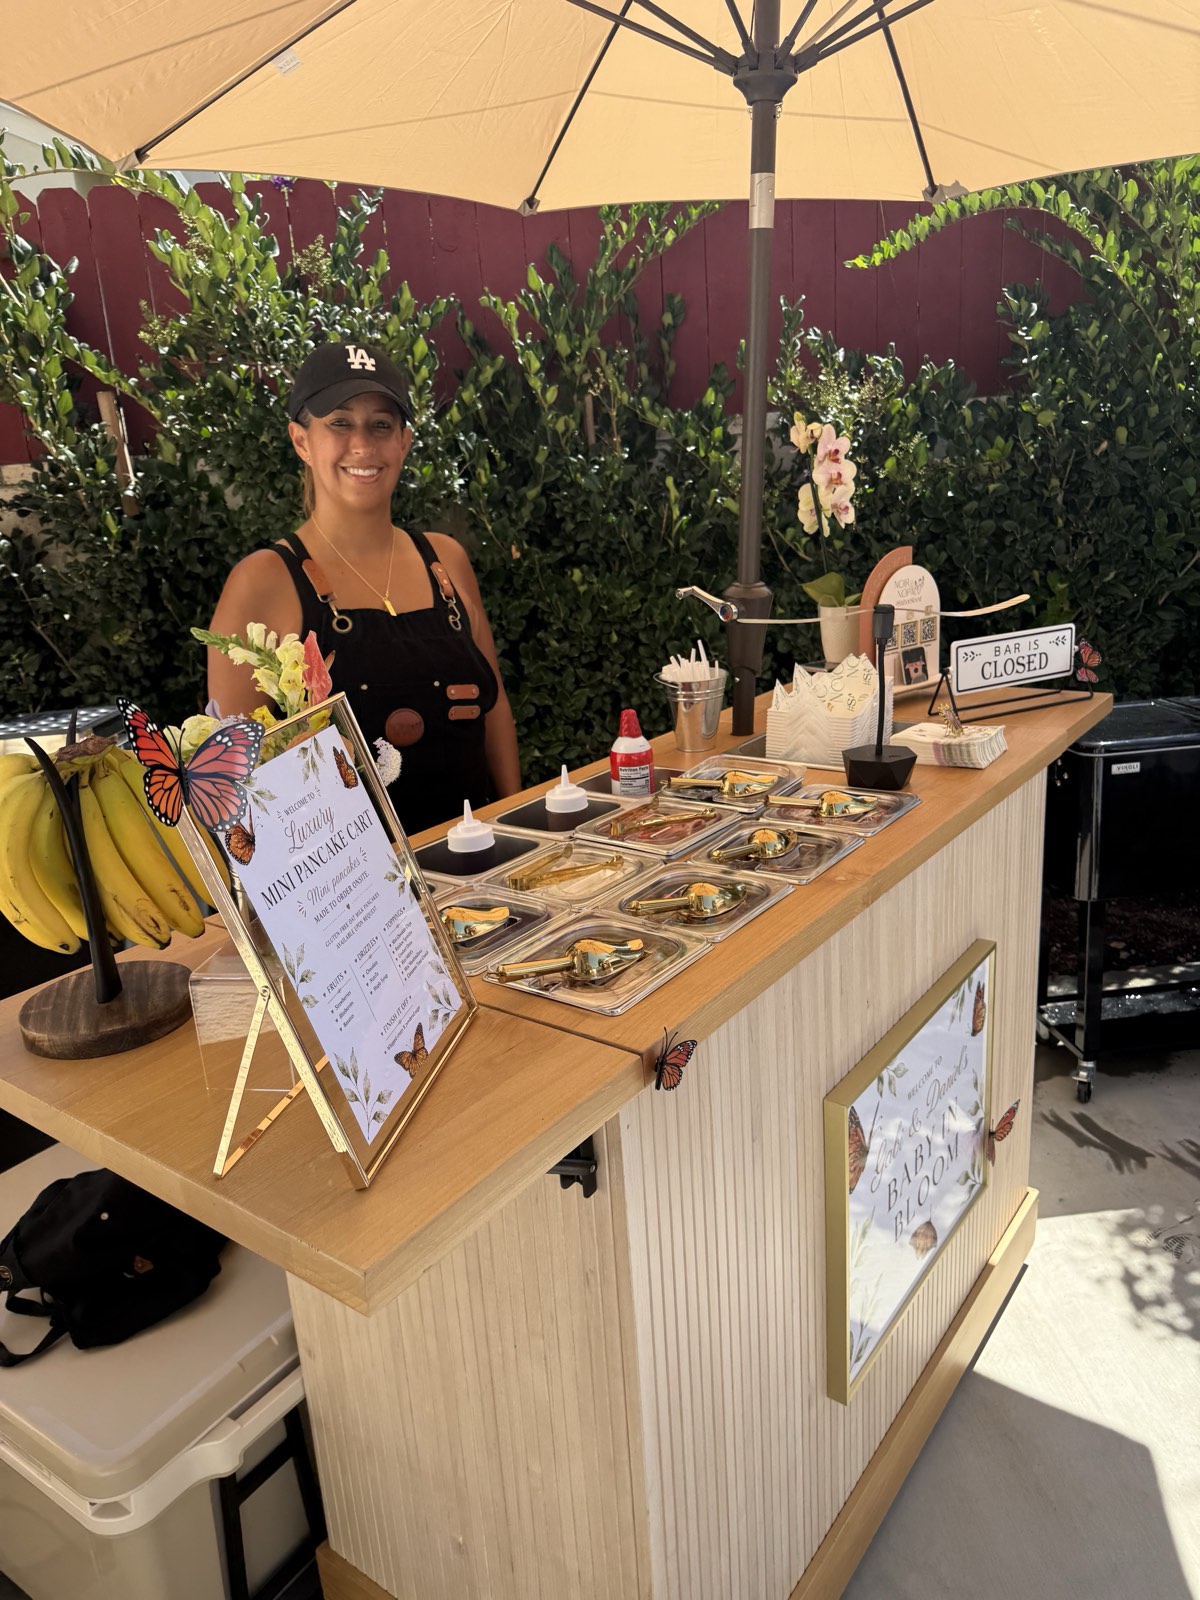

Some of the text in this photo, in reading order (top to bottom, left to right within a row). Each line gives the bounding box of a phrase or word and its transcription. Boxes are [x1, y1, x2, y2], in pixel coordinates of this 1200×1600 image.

[345, 345, 376, 371] LA
[981, 652, 1048, 680] CLOSED
[994, 639, 1039, 657] BAR IS
[284, 792, 316, 816] WELCOME TO
[284, 806, 334, 853] Luxury
[261, 809, 373, 910] MINI PANCAKE CART
[307, 856, 360, 906] Mini pancakes
[314, 907, 330, 924] MADE
[328, 900, 338, 910] TO
[336, 886, 354, 903] ORDER
[356, 937, 376, 960] DRIZZLES
[326, 972, 344, 994] FRUITS
[382, 997, 409, 1033] FINISH IT OFF
[908, 1055, 942, 1100] WELCOME TO
[909, 1107, 922, 1138] &
[888, 1096, 958, 1212] BABY IN
[894, 1132, 958, 1243] BLOOM
